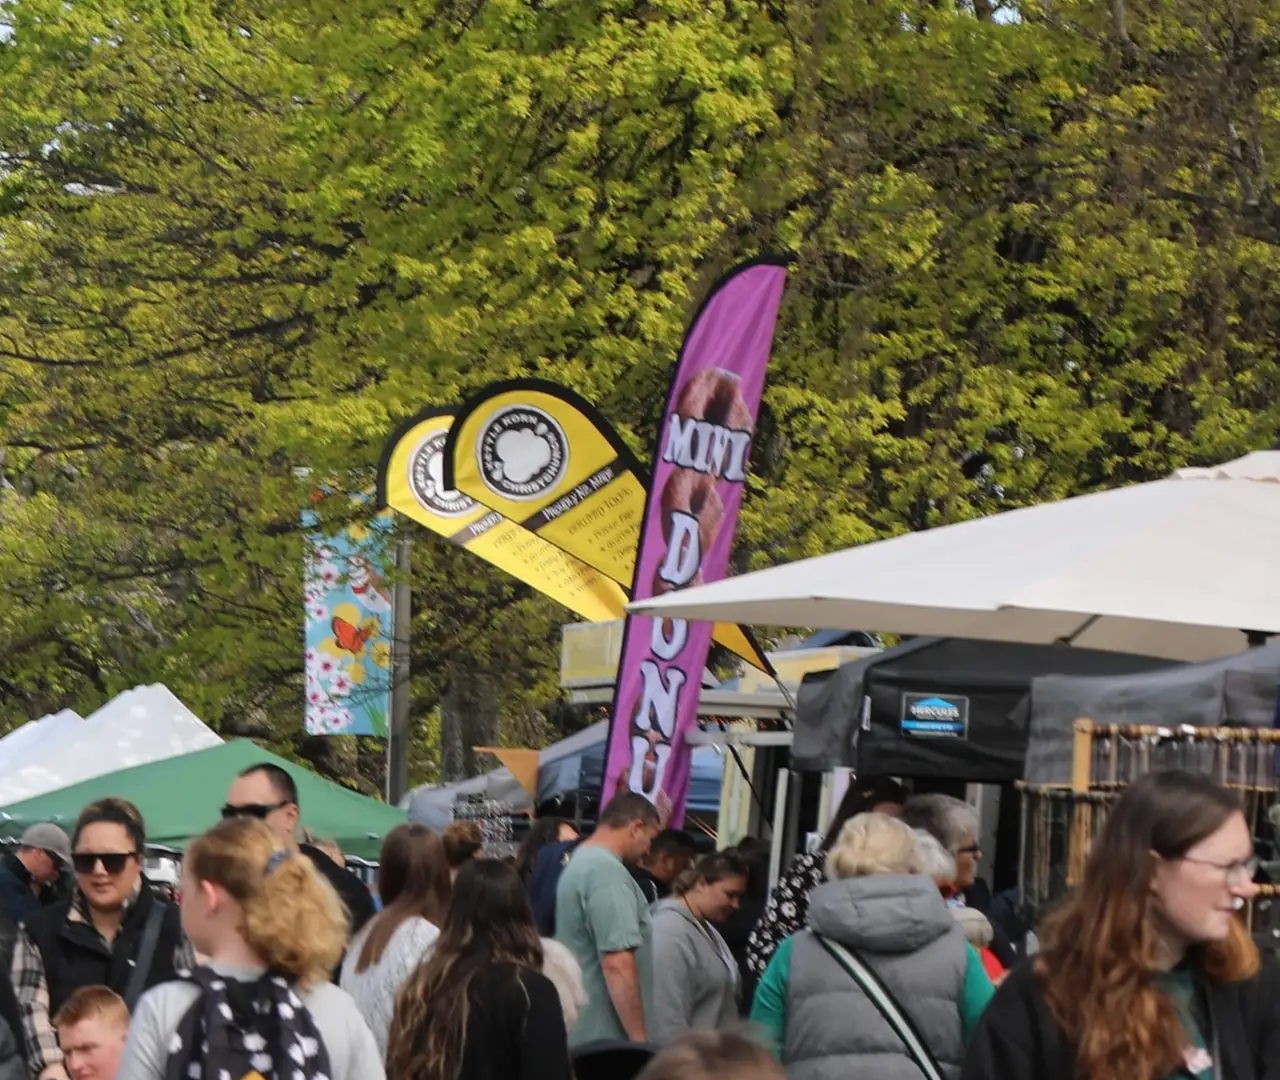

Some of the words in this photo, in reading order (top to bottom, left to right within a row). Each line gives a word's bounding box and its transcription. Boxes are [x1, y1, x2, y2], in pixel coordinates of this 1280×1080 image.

[483, 422, 503, 472] KETTLE
[501, 412, 539, 428] KORN
[662, 412, 752, 483] MINI
